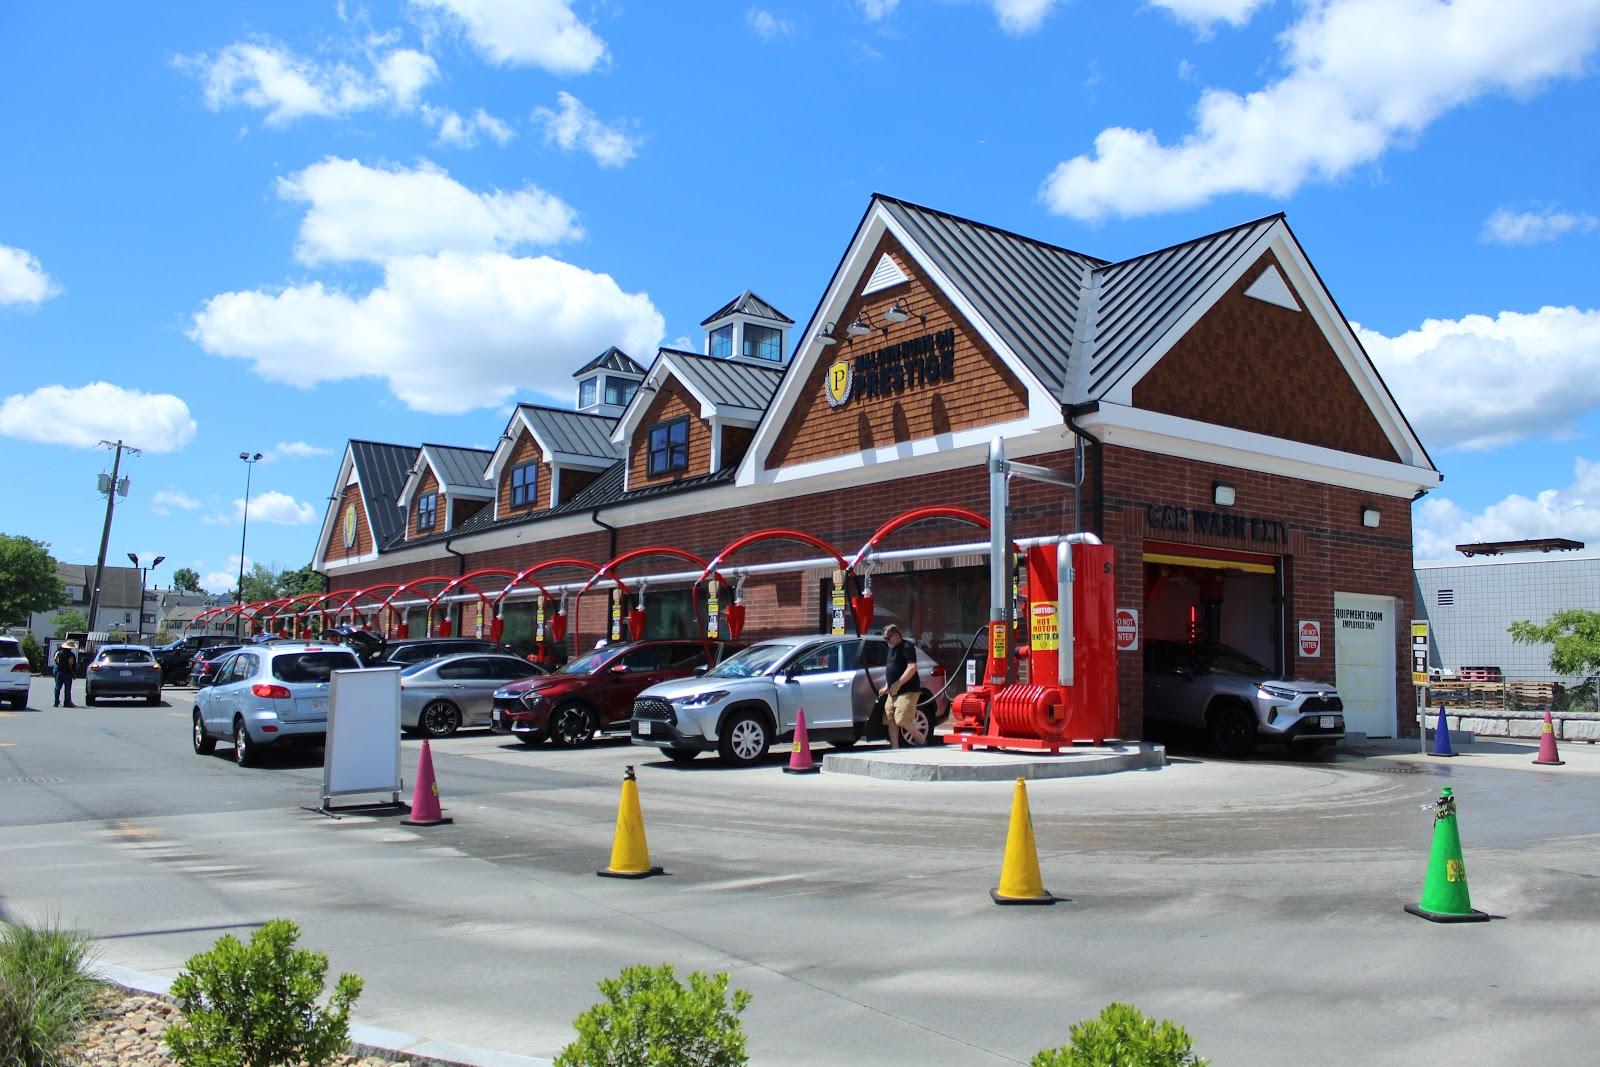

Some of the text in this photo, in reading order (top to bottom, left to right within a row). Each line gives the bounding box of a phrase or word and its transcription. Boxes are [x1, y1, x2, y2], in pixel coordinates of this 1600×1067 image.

[833, 370, 844, 391] P
[853, 351, 953, 400] PRESTIGE
[1150, 503, 1288, 544] CAR WASH EXIT
[1032, 606, 1057, 615] CAUTION
[1366, 611, 1383, 621] ROOM
[1342, 620, 1375, 630] EMPLOYEES ONLY
[1117, 633, 1134, 641] NTER
[1302, 641, 1317, 649] ENTER
